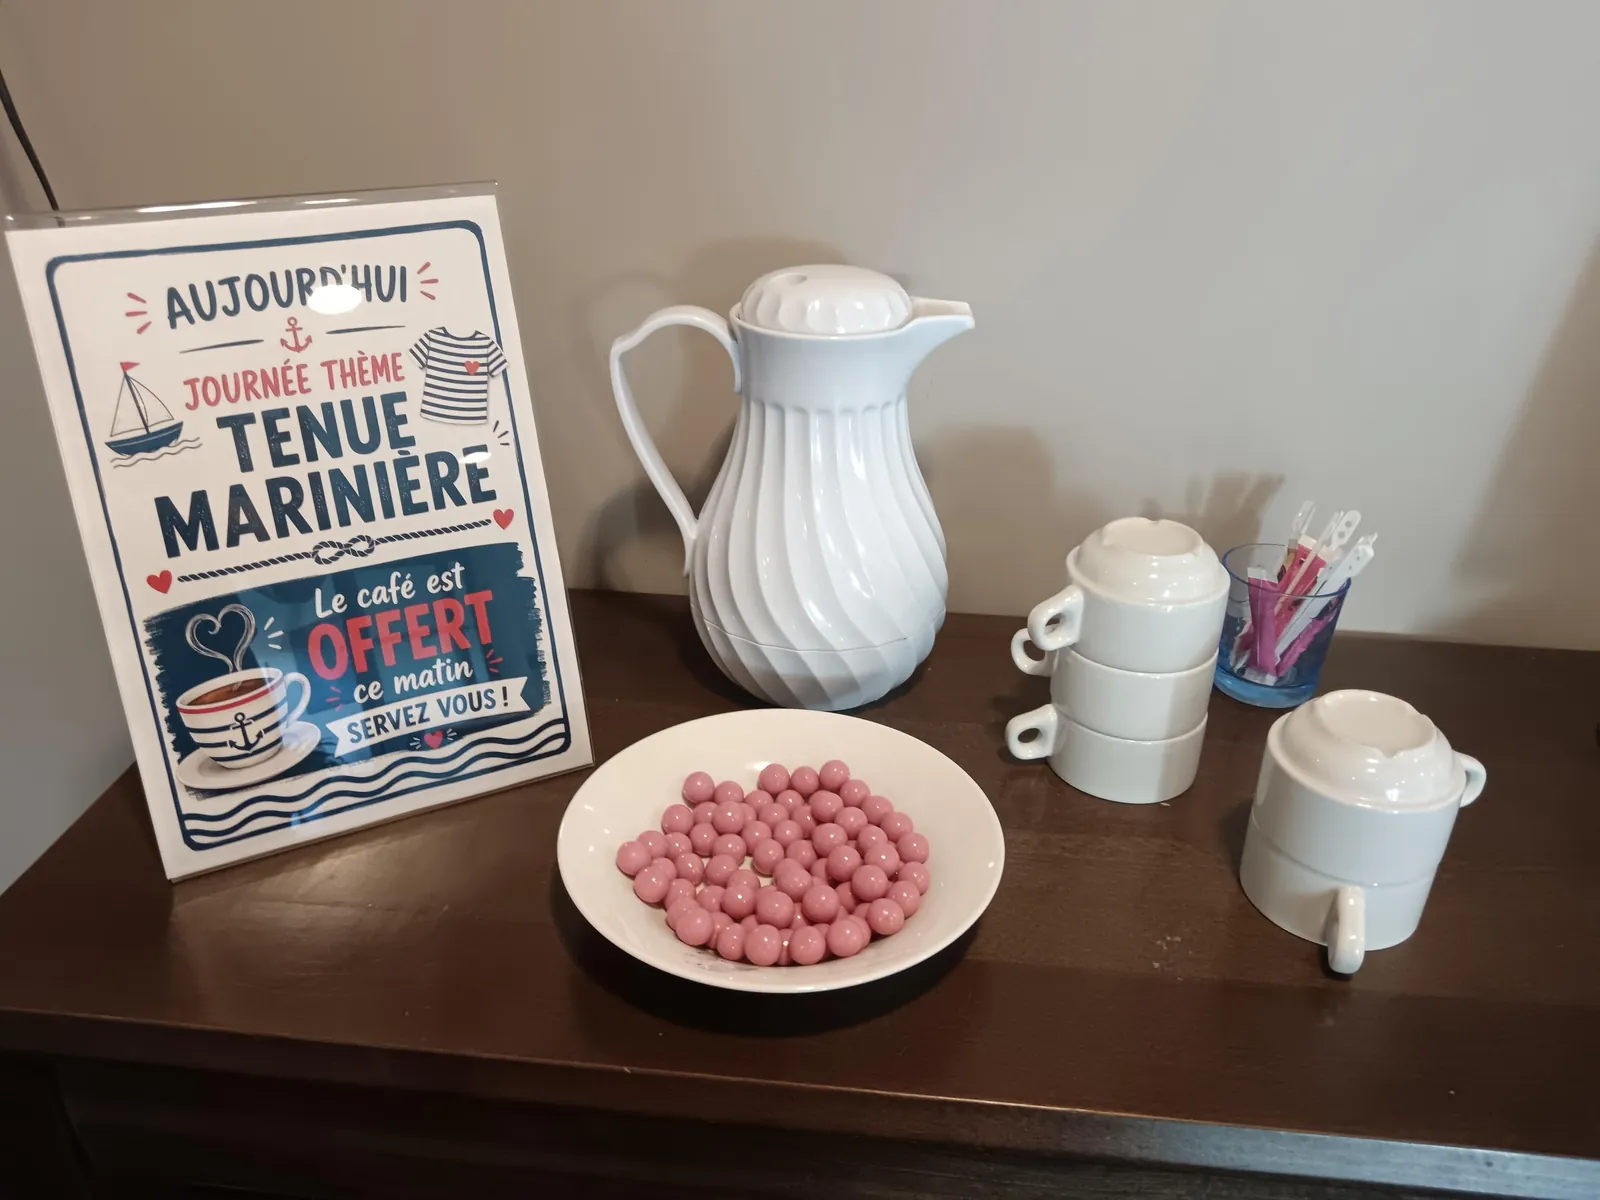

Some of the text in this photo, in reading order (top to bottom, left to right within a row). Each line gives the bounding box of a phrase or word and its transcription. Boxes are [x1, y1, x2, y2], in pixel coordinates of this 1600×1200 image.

[183, 350, 405, 411] JOURNÉE THÈME
[216, 391, 416, 473] TENUE
[154, 444, 497, 559] MARINIÈRE
[315, 561, 465, 618] Le café est
[308, 590, 493, 680] OFFERT
[354, 658, 473, 704] ce matin
[347, 701, 430, 744] SERVEZ
